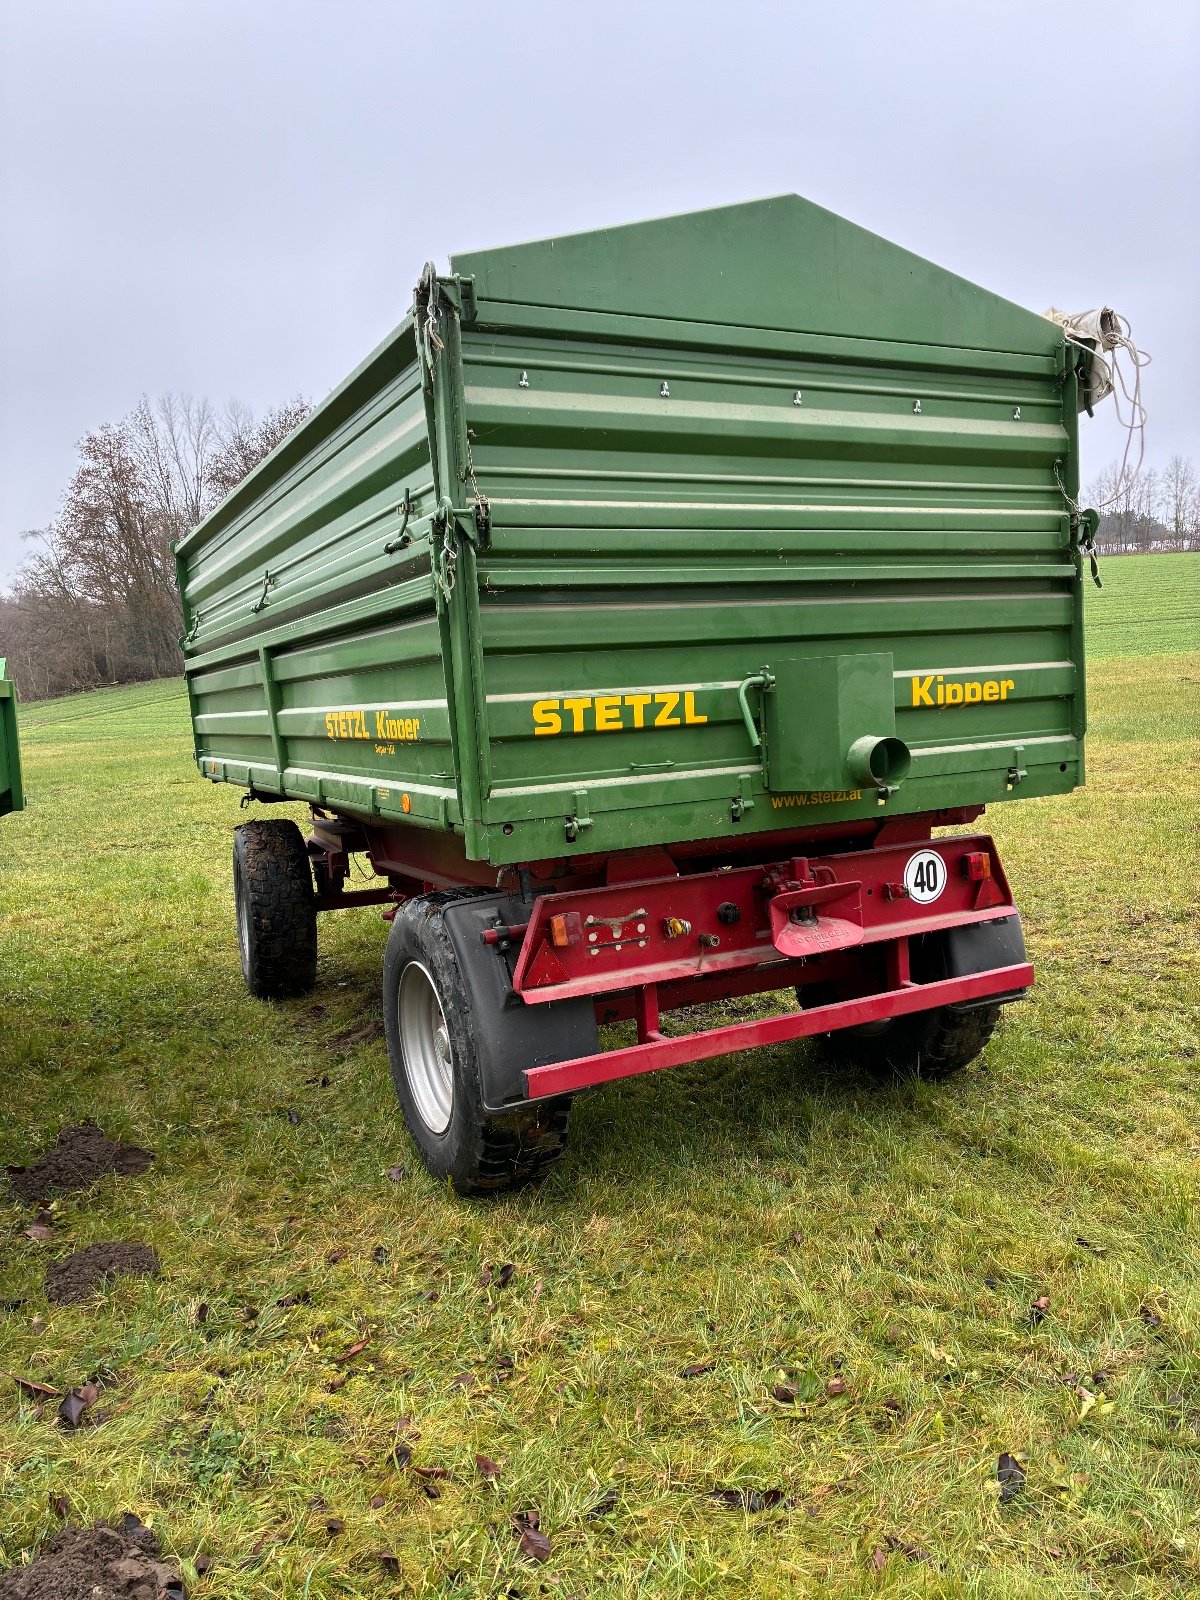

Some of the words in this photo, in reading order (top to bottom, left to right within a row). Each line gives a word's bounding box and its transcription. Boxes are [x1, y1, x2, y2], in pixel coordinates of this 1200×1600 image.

[532, 691, 708, 736] STETZL
[911, 675, 1015, 709] Kipper
[325, 710, 370, 739] STETZL
[375, 710, 420, 741] Kipper
[771, 789, 862, 809] www.stetzl.at
[913, 859, 938, 893] 40
